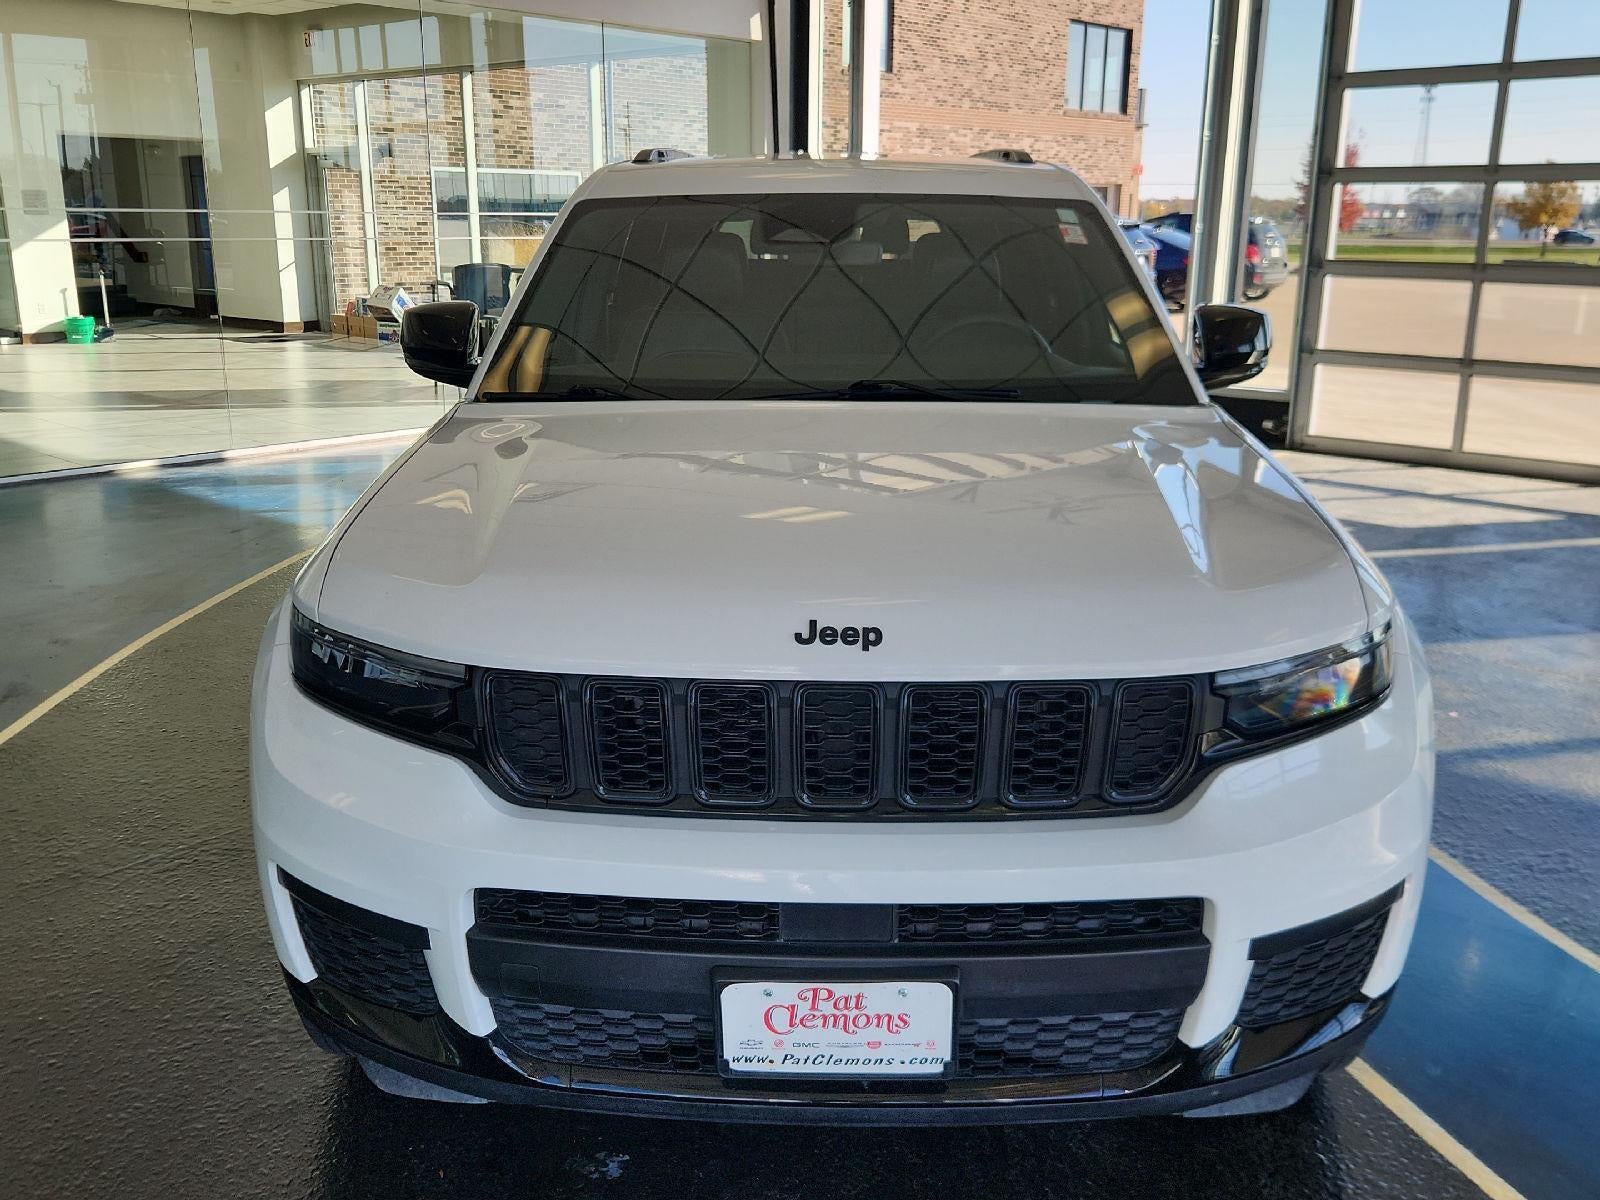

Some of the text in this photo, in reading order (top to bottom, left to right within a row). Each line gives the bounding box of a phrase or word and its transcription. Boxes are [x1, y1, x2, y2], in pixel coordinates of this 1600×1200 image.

[794, 619, 883, 651] Jeep
[798, 986, 867, 1012] Pat
[763, 1004, 911, 1036] Clemons
